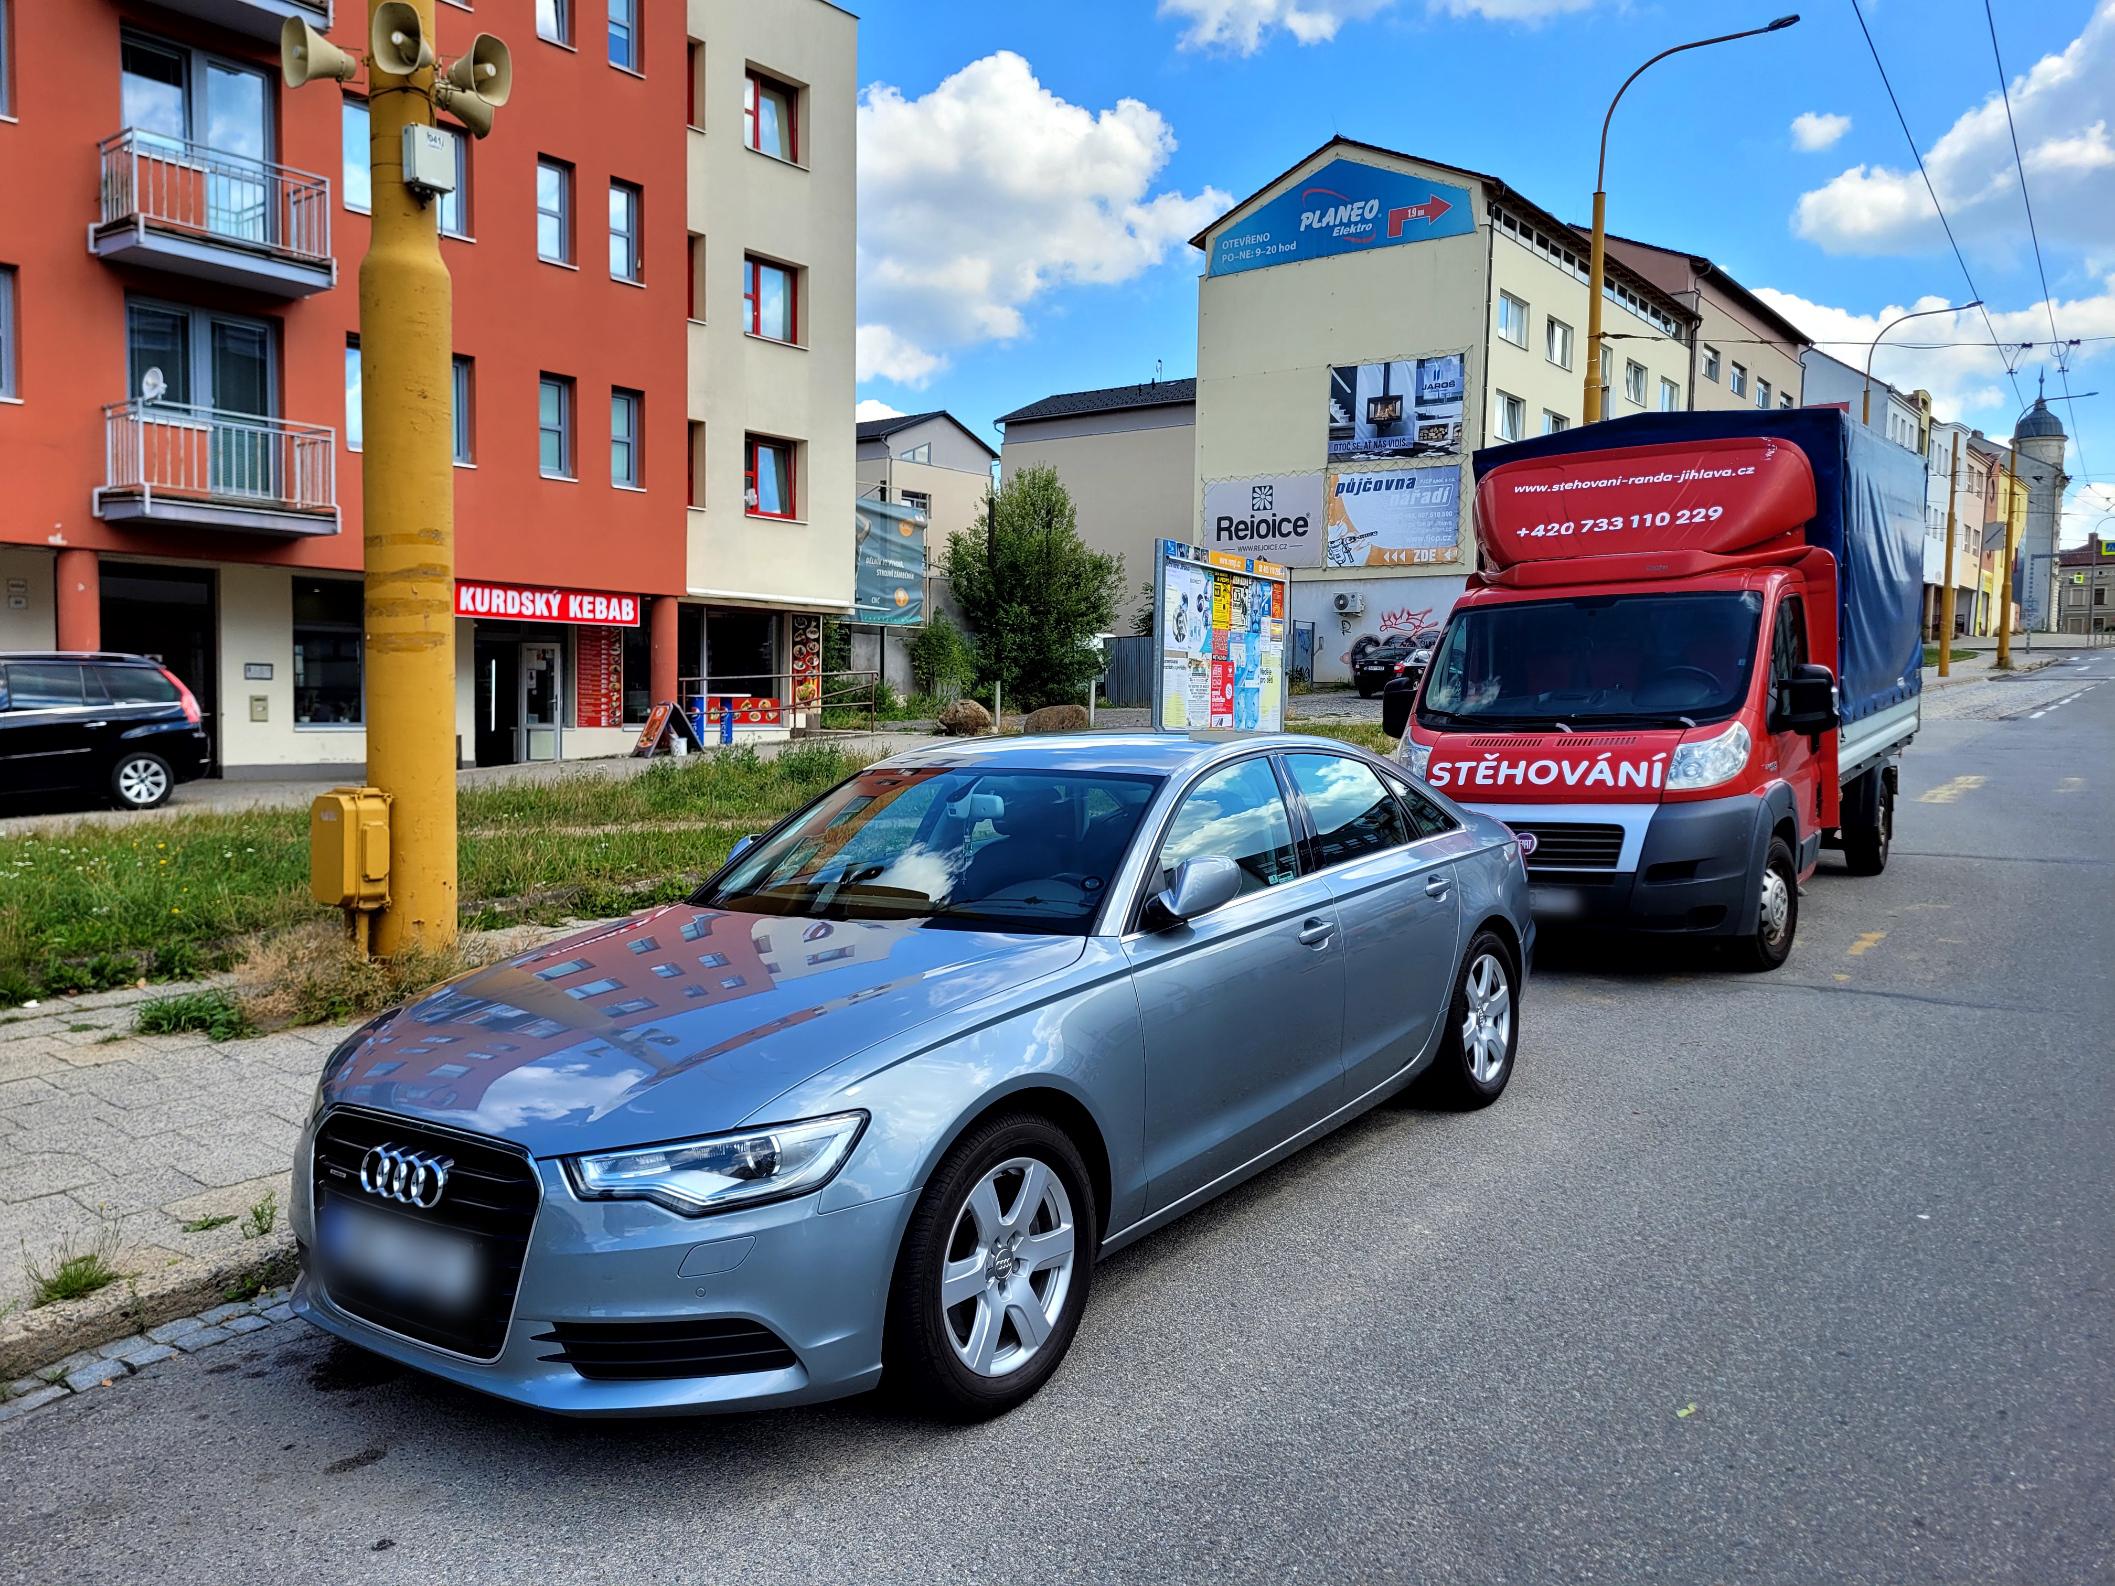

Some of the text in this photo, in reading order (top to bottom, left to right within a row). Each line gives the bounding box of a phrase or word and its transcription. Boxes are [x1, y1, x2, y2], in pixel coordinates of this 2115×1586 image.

[1300, 198, 1379, 232] PLANEO
[1222, 232, 1271, 250] OTEVŘENO
[1332, 223, 1373, 237] Elektro
[1278, 240, 1297, 253] hod
[1334, 476, 1417, 497] půjčovna
[1513, 464, 1755, 493] www.stehovani-randa-jihlava.cz
[1216, 512, 1309, 542] Rejoice
[1516, 506, 1724, 538] +420 733 110 229
[1238, 543, 1288, 553] WWW.REJOICE.CZ
[1413, 549, 1437, 562] ZDE
[459, 586, 634, 621] KURDSKÝ KEBAB
[1429, 752, 1668, 788] STĚHOVÁNÍ
